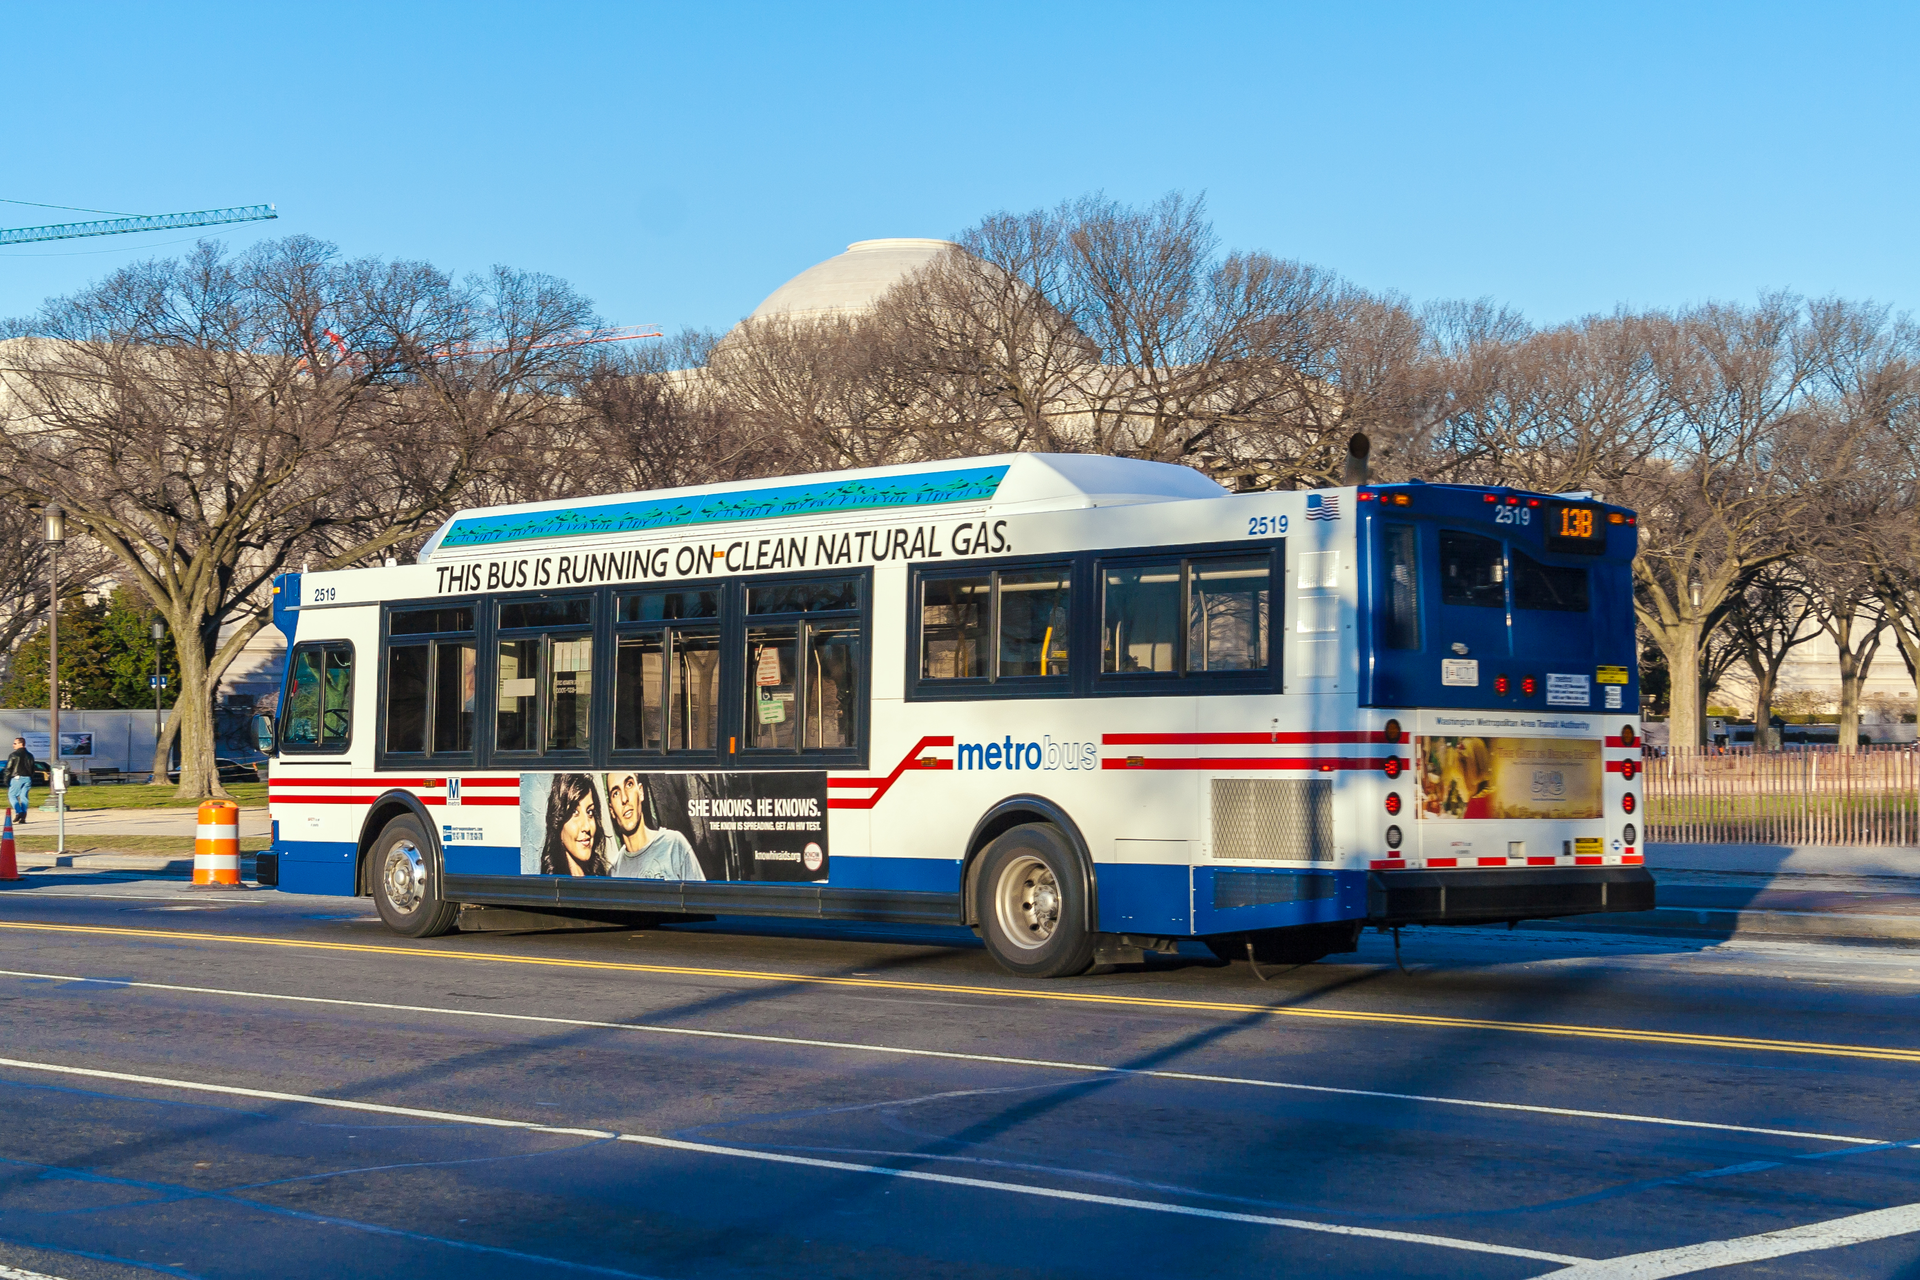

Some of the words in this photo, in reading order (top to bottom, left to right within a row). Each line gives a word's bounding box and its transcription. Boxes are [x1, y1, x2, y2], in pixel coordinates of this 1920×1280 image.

[1248, 515, 1289, 536] 2519
[1495, 505, 1531, 526] 2519
[1560, 508, 1593, 537] 13B
[436, 563, 482, 593] THIS
[487, 559, 528, 590] BUS
[533, 557, 552, 586] IS
[557, 548, 669, 584] RUNNING
[676, 544, 715, 576] ON
[725, 536, 808, 572] CLEAN
[814, 526, 942, 566] NATURAL
[951, 520, 1012, 556] GAS.
[314, 587, 336, 602] 2519
[958, 735, 1098, 771] metrobus
[449, 779, 459, 799] M
[687, 799, 710, 817] SHE
[711, 798, 755, 817] KNOWS.
[757, 798, 773, 817] HE
[774, 798, 822, 817] KNOWS.
[709, 821, 720, 831] THE
[720, 821, 736, 831] KNOW
[737, 821, 744, 831] IS
[775, 821, 786, 831] GET
[786, 821, 796, 831] AN
[795, 821, 805, 831] HIV
